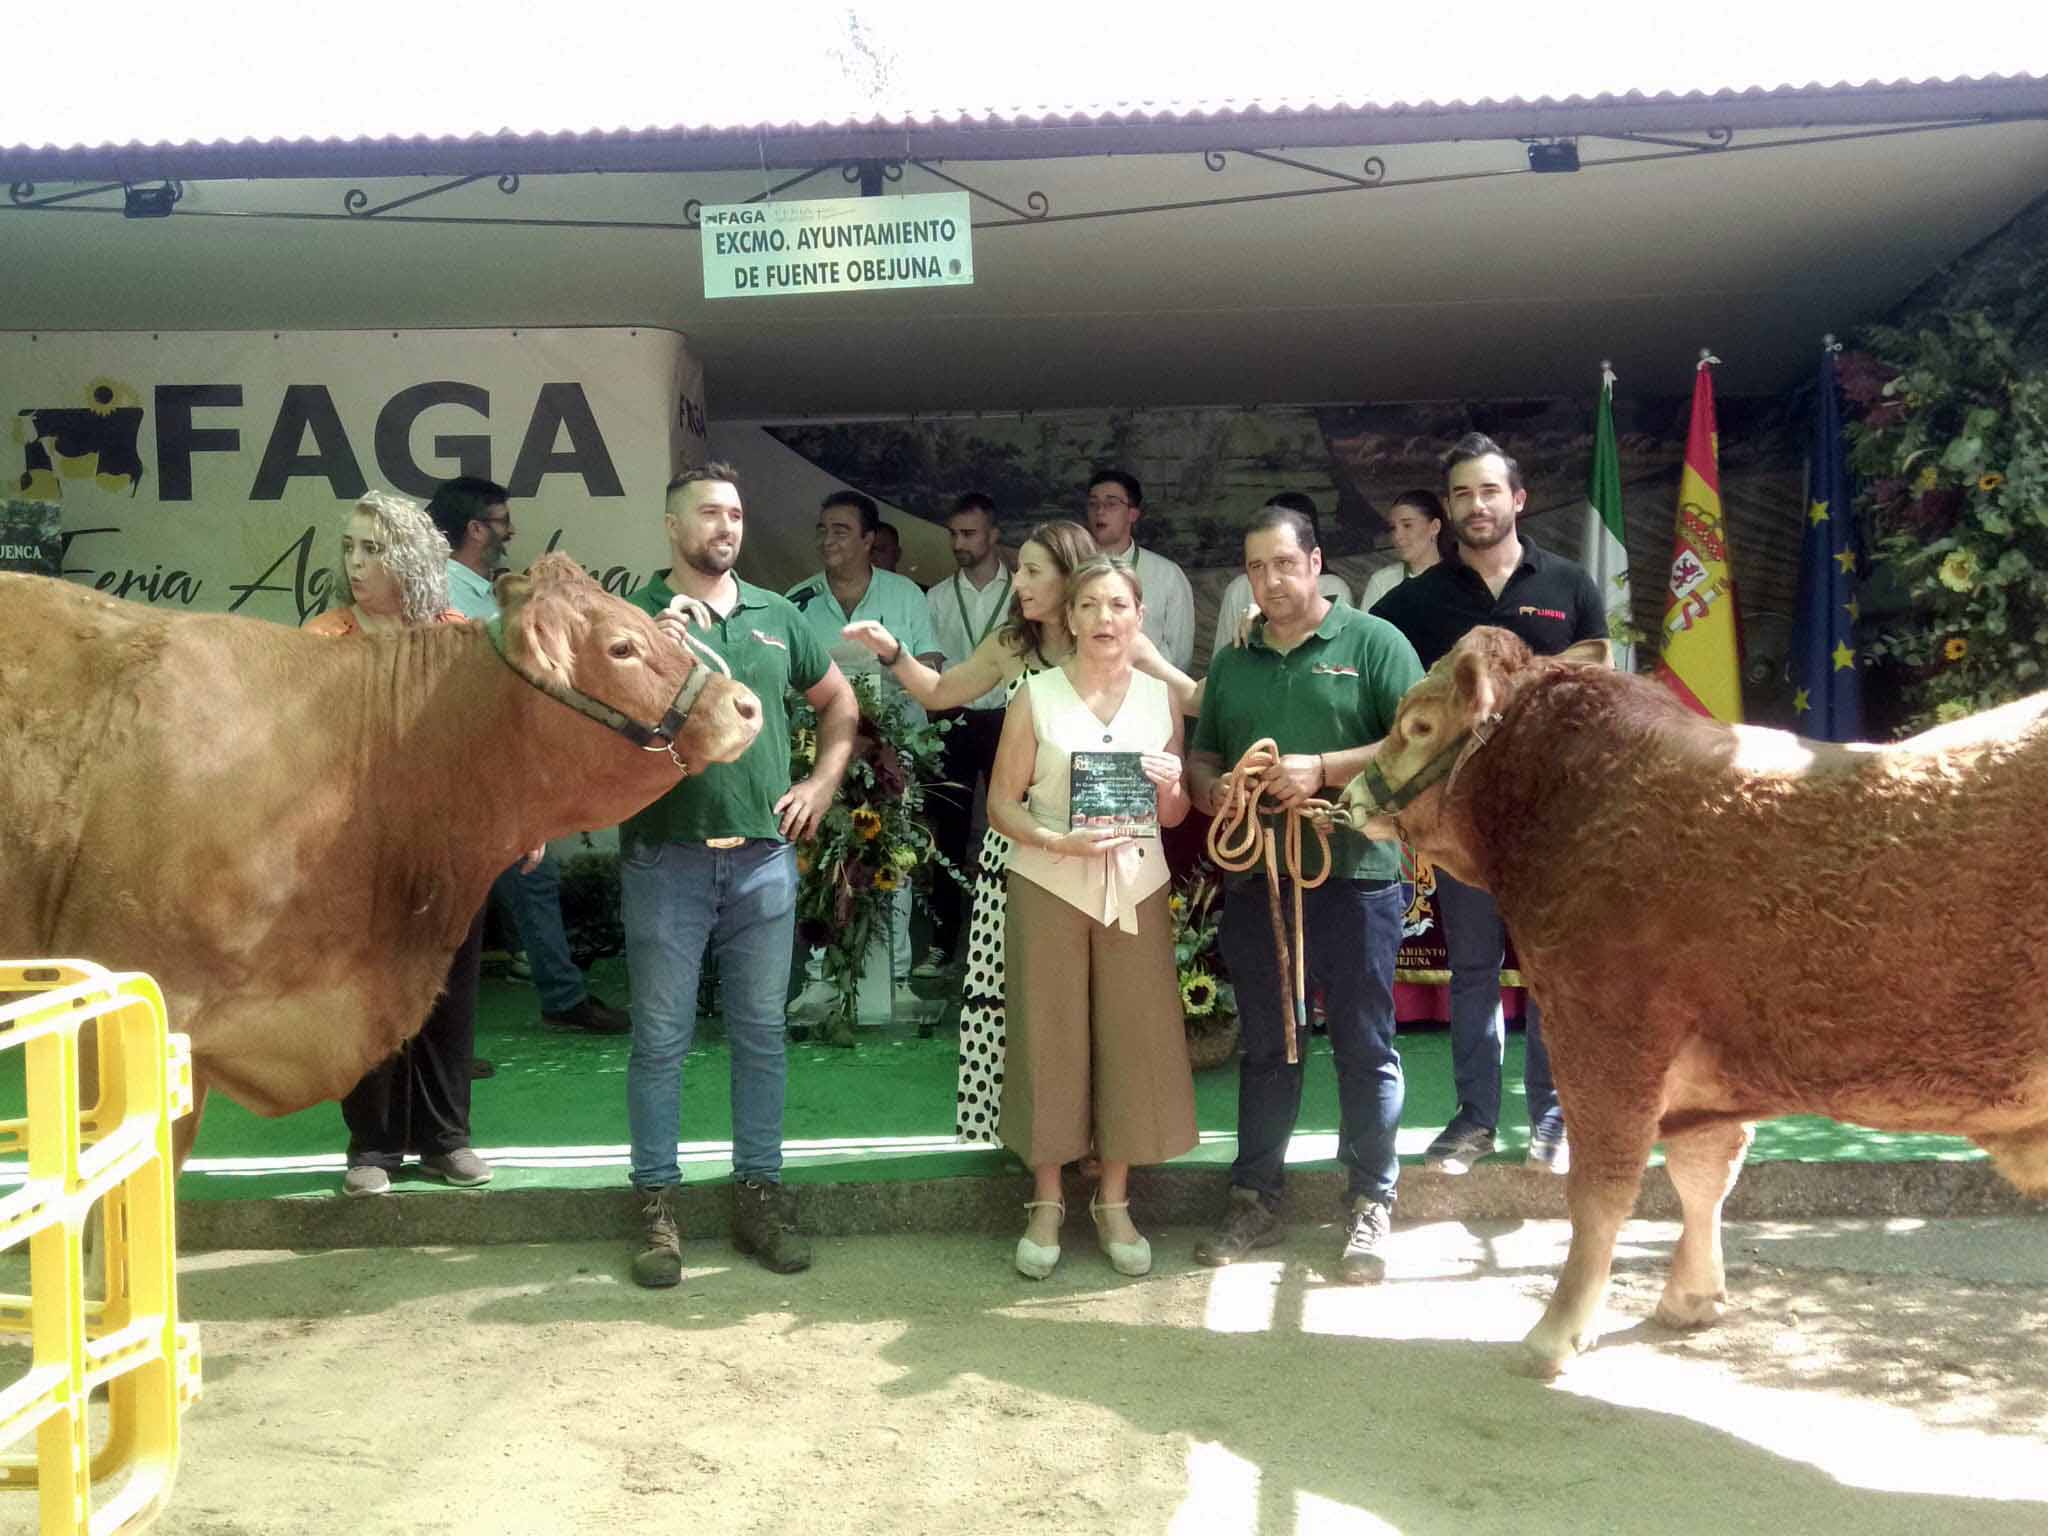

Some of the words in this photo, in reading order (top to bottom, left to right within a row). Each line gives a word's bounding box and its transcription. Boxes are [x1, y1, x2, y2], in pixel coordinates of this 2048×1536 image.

[718, 210, 766, 225] FAGA
[716, 229, 790, 255] EXCMO.
[797, 219, 956, 250] AYUNTAMIENTO
[734, 267, 759, 289] DE
[766, 262, 840, 287] FUENTE
[846, 256, 942, 282] OBEJUNA
[154, 382, 626, 501] FAGA
[0, 545, 42, 560] UENCA
[1399, 947, 1447, 957] AMIENTO
[1399, 957, 1431, 967] EJUNA
